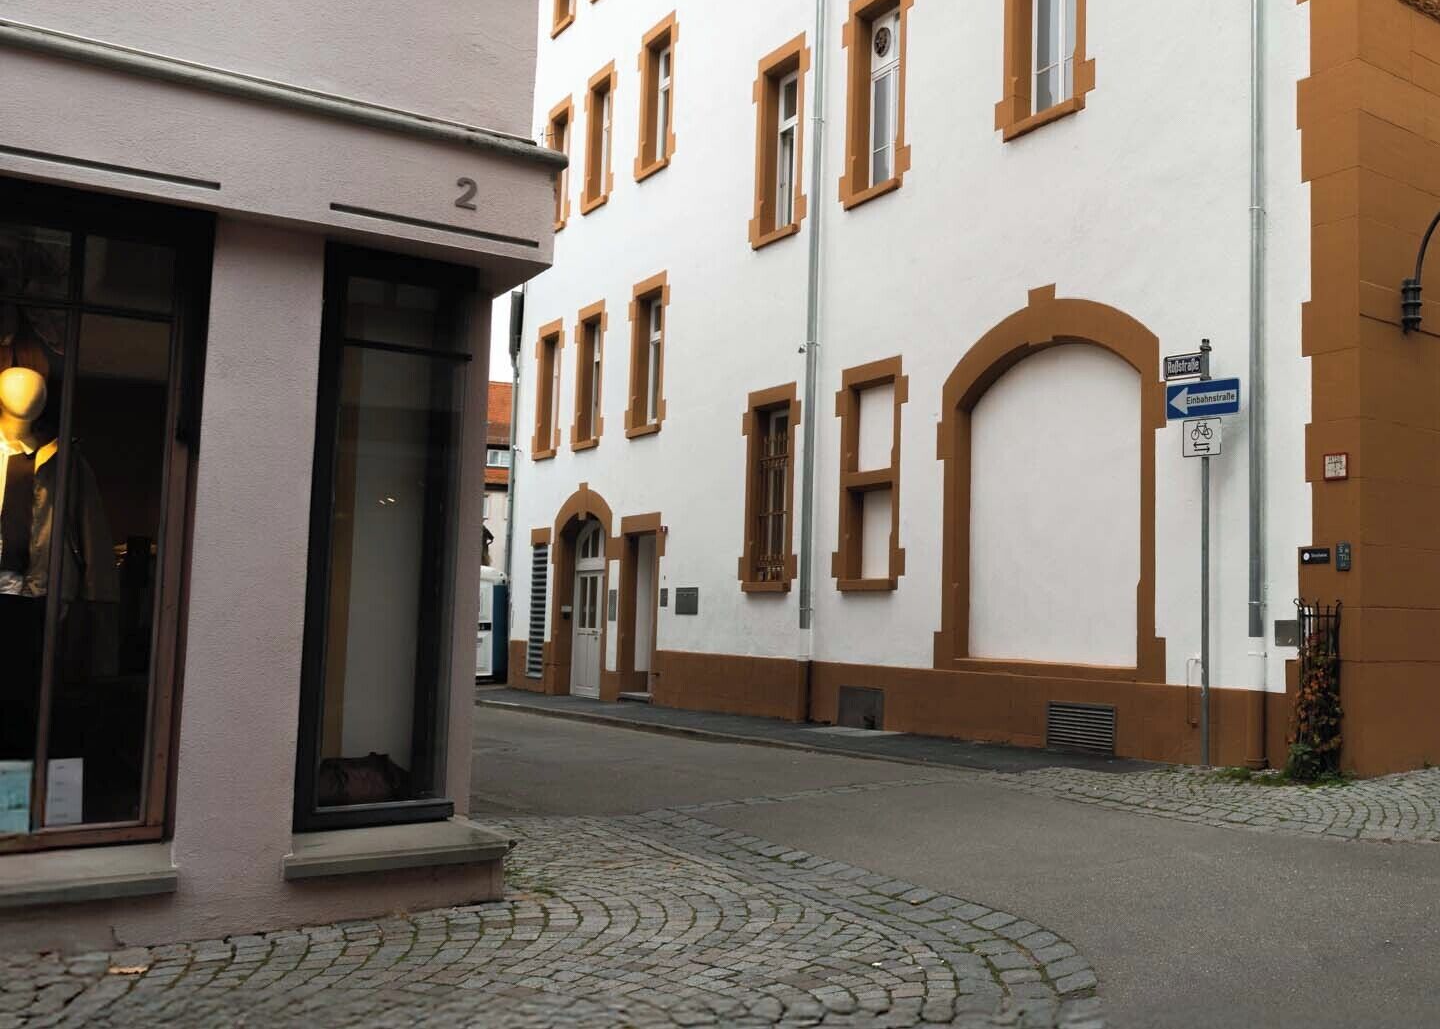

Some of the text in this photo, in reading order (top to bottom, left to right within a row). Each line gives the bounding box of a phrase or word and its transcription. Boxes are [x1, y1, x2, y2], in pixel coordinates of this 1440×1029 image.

[455, 177, 477, 210] 2
[1167, 358, 1200, 374] Roßstraße
[1186, 392, 1235, 405] Einbahnstraße
